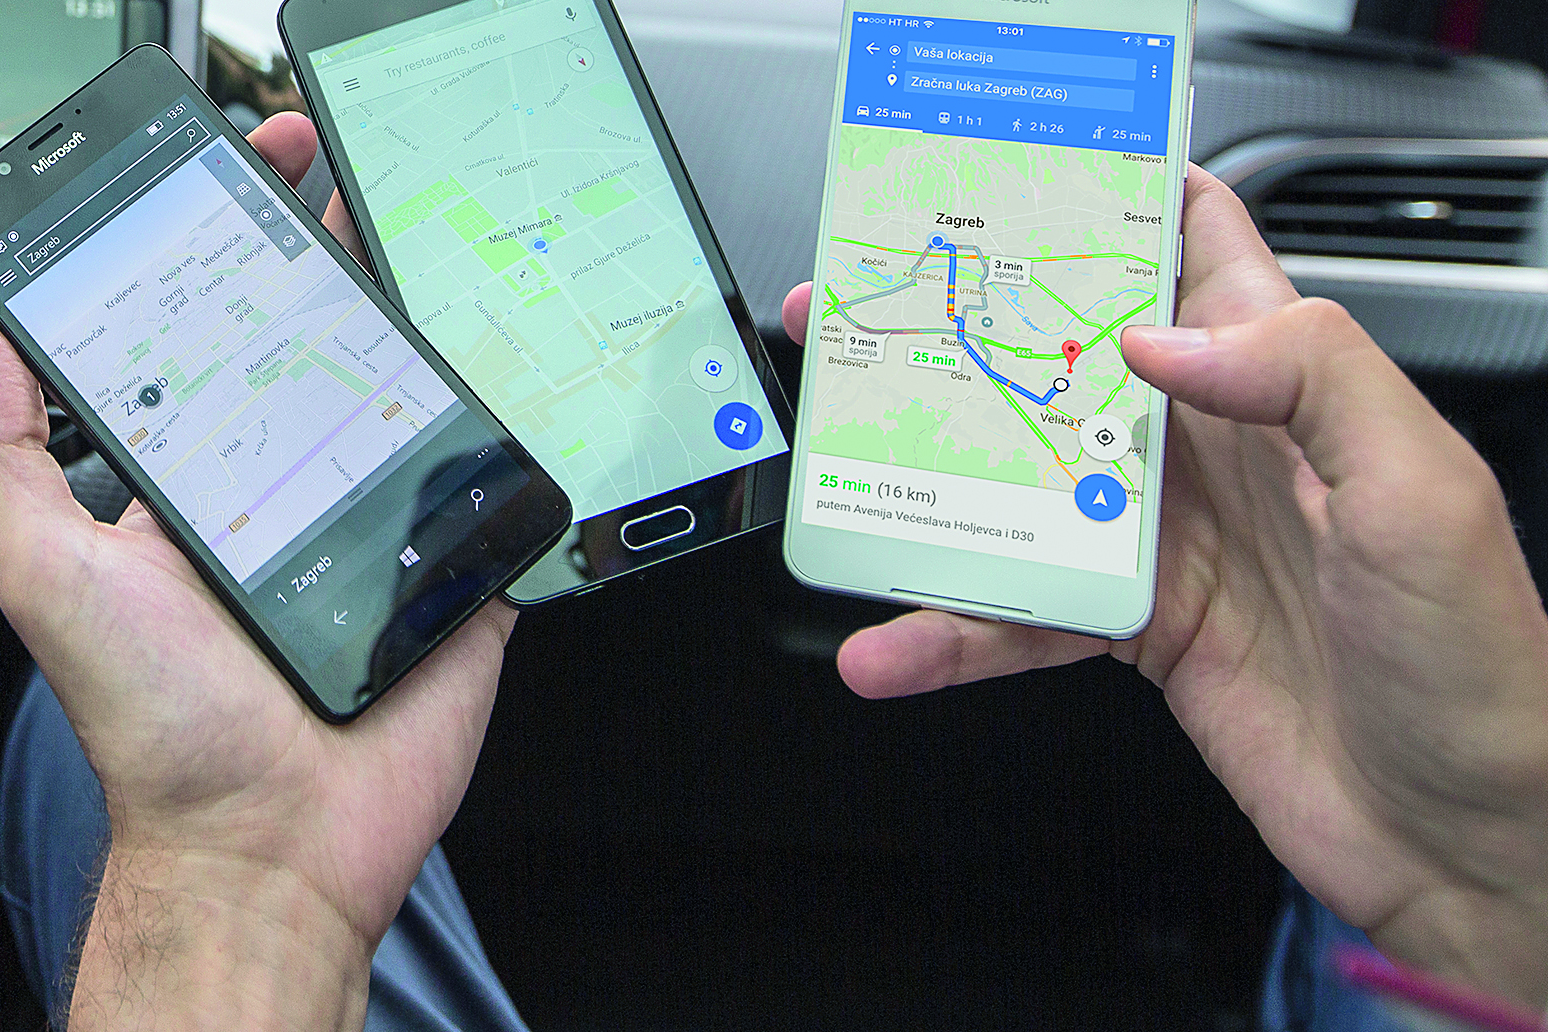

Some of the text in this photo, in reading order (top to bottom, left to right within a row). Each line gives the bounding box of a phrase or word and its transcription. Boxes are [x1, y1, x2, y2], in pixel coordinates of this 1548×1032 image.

[888, 18, 920, 28] HT HR
[996, 26, 1024, 36] 13:01
[384, 33, 506, 79] Try restaurants, coffee
[913, 46, 994, 65] Vaša lokacija
[440, 75, 461, 91] Grada
[911, 76, 1068, 103] Zračna luka Zagreb (ZAG)
[544, 82, 570, 109] Tratinska
[166, 103, 187, 121] 13:51
[875, 107, 912, 120] 25 min
[957, 115, 982, 126] 1 h 1
[383, 126, 411, 148] Plitvička
[462, 117, 495, 143] Koturaška
[599, 126, 631, 142] Brozova
[1030, 121, 1064, 134] 2 h 26
[1112, 129, 1152, 142] 25 min
[30, 131, 87, 176] Microsoft
[1122, 153, 1162, 164] Markovo
[495, 157, 539, 178] Valentići
[572, 177, 600, 194] Izidora
[600, 159, 640, 182] Kršnjavog
[935, 212, 985, 229] Zagreb
[1123, 211, 1163, 225] Sesvet
[488, 218, 553, 245] Muzej Mimara
[26, 235, 61, 264] Zagreb
[200, 232, 244, 268] Medveščak
[236, 241, 268, 266] Ribnjak
[570, 232, 651, 280] prilaz Gjure Deželića
[158, 254, 196, 285] Nova ves
[861, 257, 888, 267] Kočići
[995, 260, 1023, 272] 3 min
[1126, 266, 1152, 277] Ivanja
[198, 273, 226, 297] Centar
[994, 270, 1025, 281] sporija
[104, 279, 142, 310] Kraljevec
[158, 284, 185, 307] Gornji
[959, 288, 988, 297] UTRINA
[169, 296, 190, 316] grad
[225, 294, 249, 315] Donji
[235, 303, 255, 324] grad
[474, 299, 519, 347] Gundulićeva
[610, 302, 674, 332] Muzej iluzija
[1022, 316, 1038, 332] Sava
[65, 324, 108, 359] Pantovčak
[621, 340, 641, 356] Ilica
[850, 337, 877, 348] 9 min
[941, 337, 965, 348] Buzin
[245, 338, 290, 375] Martinovka
[332, 336, 379, 374] Trnjanska cesta
[828, 356, 869, 369] Brezovica
[849, 347, 878, 358] sporija
[912, 351, 956, 367] 25 min
[1017, 348, 1032, 357] E65
[950, 371, 972, 382] Odra
[95, 387, 111, 400] Ilica
[113, 375, 143, 399] Deželića
[146, 391, 155, 402] 1
[396, 384, 425, 409] Trnjanska
[1040, 412, 1074, 427] Velika
[219, 438, 244, 459] Vrbik
[329, 456, 355, 484] Prisavlje
[819, 473, 937, 507] 25 min (16 km)
[816, 498, 851, 512] putem
[853, 504, 893, 521] Avenija
[895, 511, 951, 529] Većeslava
[954, 520, 1002, 537] Holjevca
[1012, 529, 1035, 543] D30
[277, 556, 333, 604] 1 Zagreb
